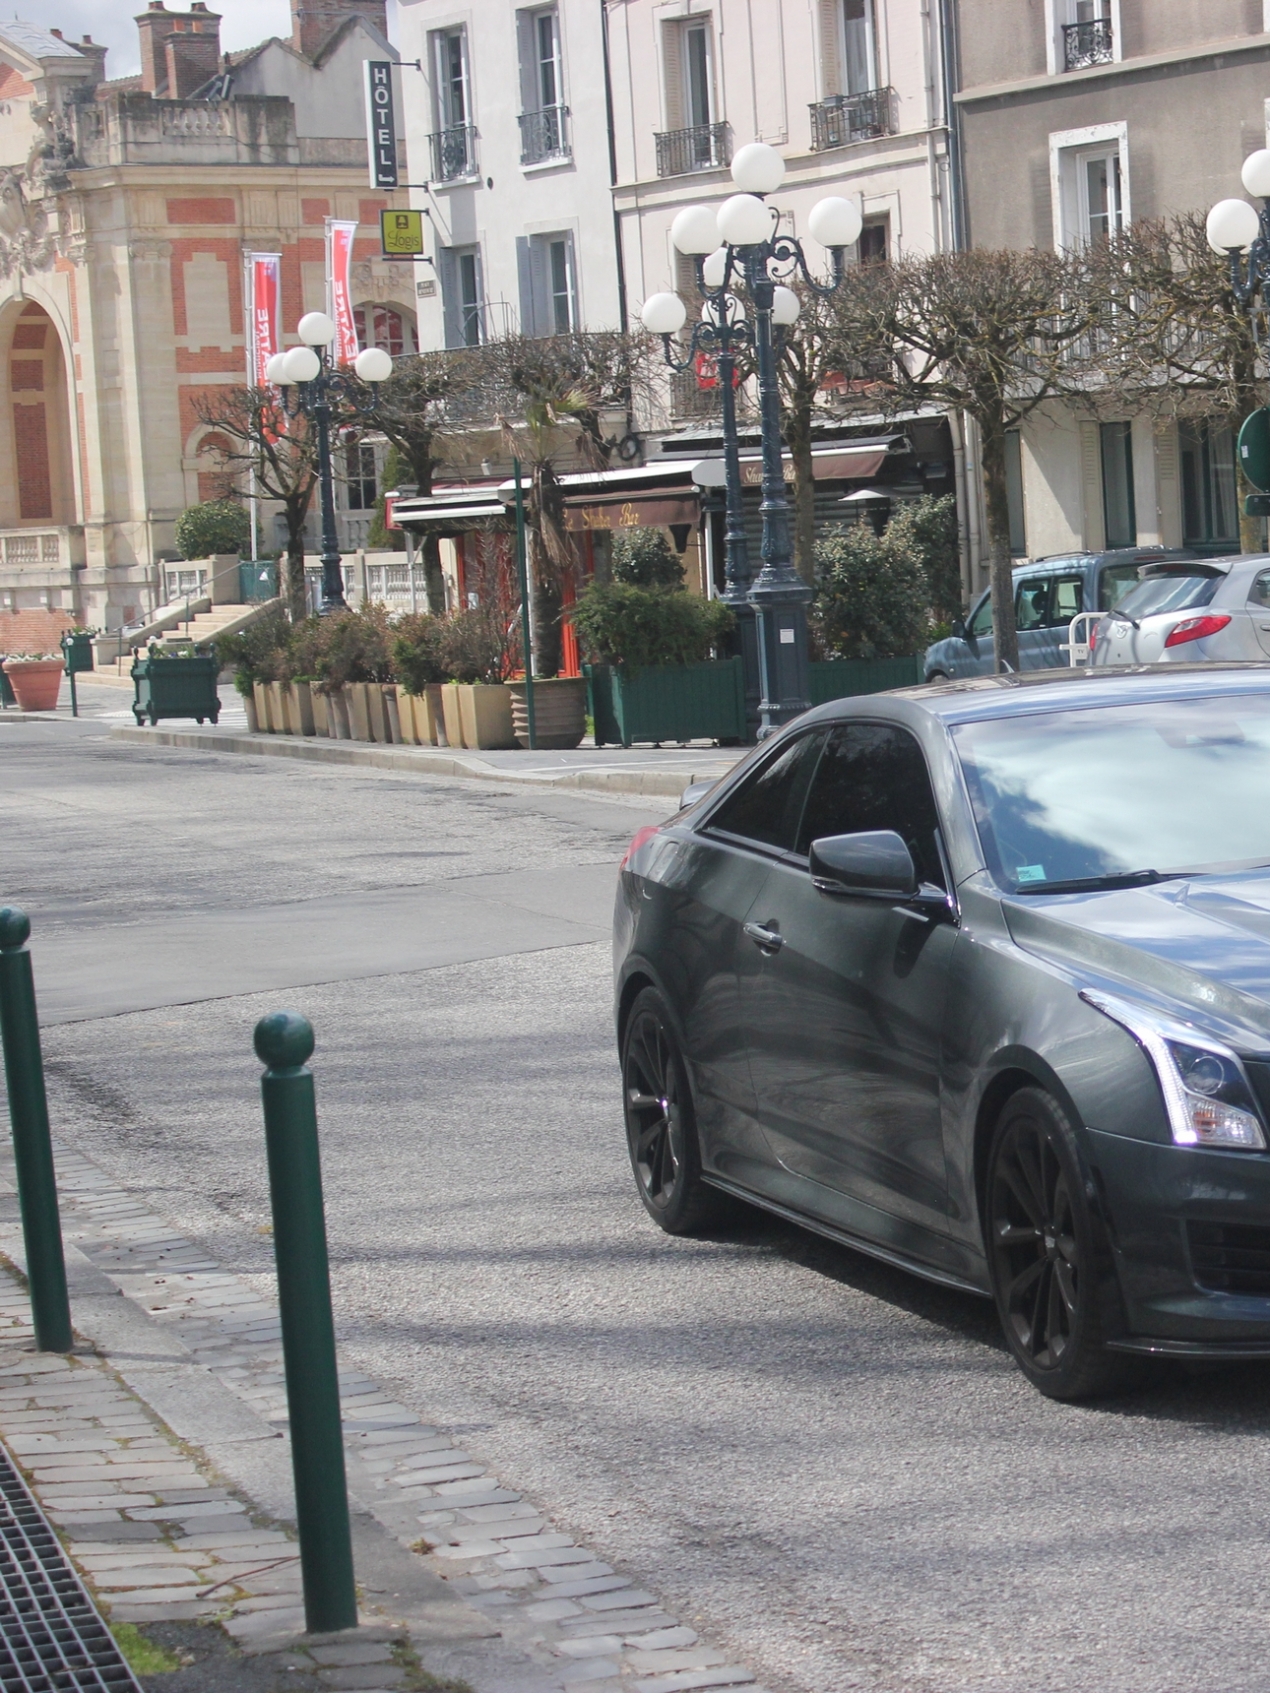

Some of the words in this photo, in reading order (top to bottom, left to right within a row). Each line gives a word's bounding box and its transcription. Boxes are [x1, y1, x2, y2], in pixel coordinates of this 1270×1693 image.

[373, 68, 392, 165] HÔTEL
[388, 230, 419, 250] Logis
[619, 502, 639, 526] Bar
